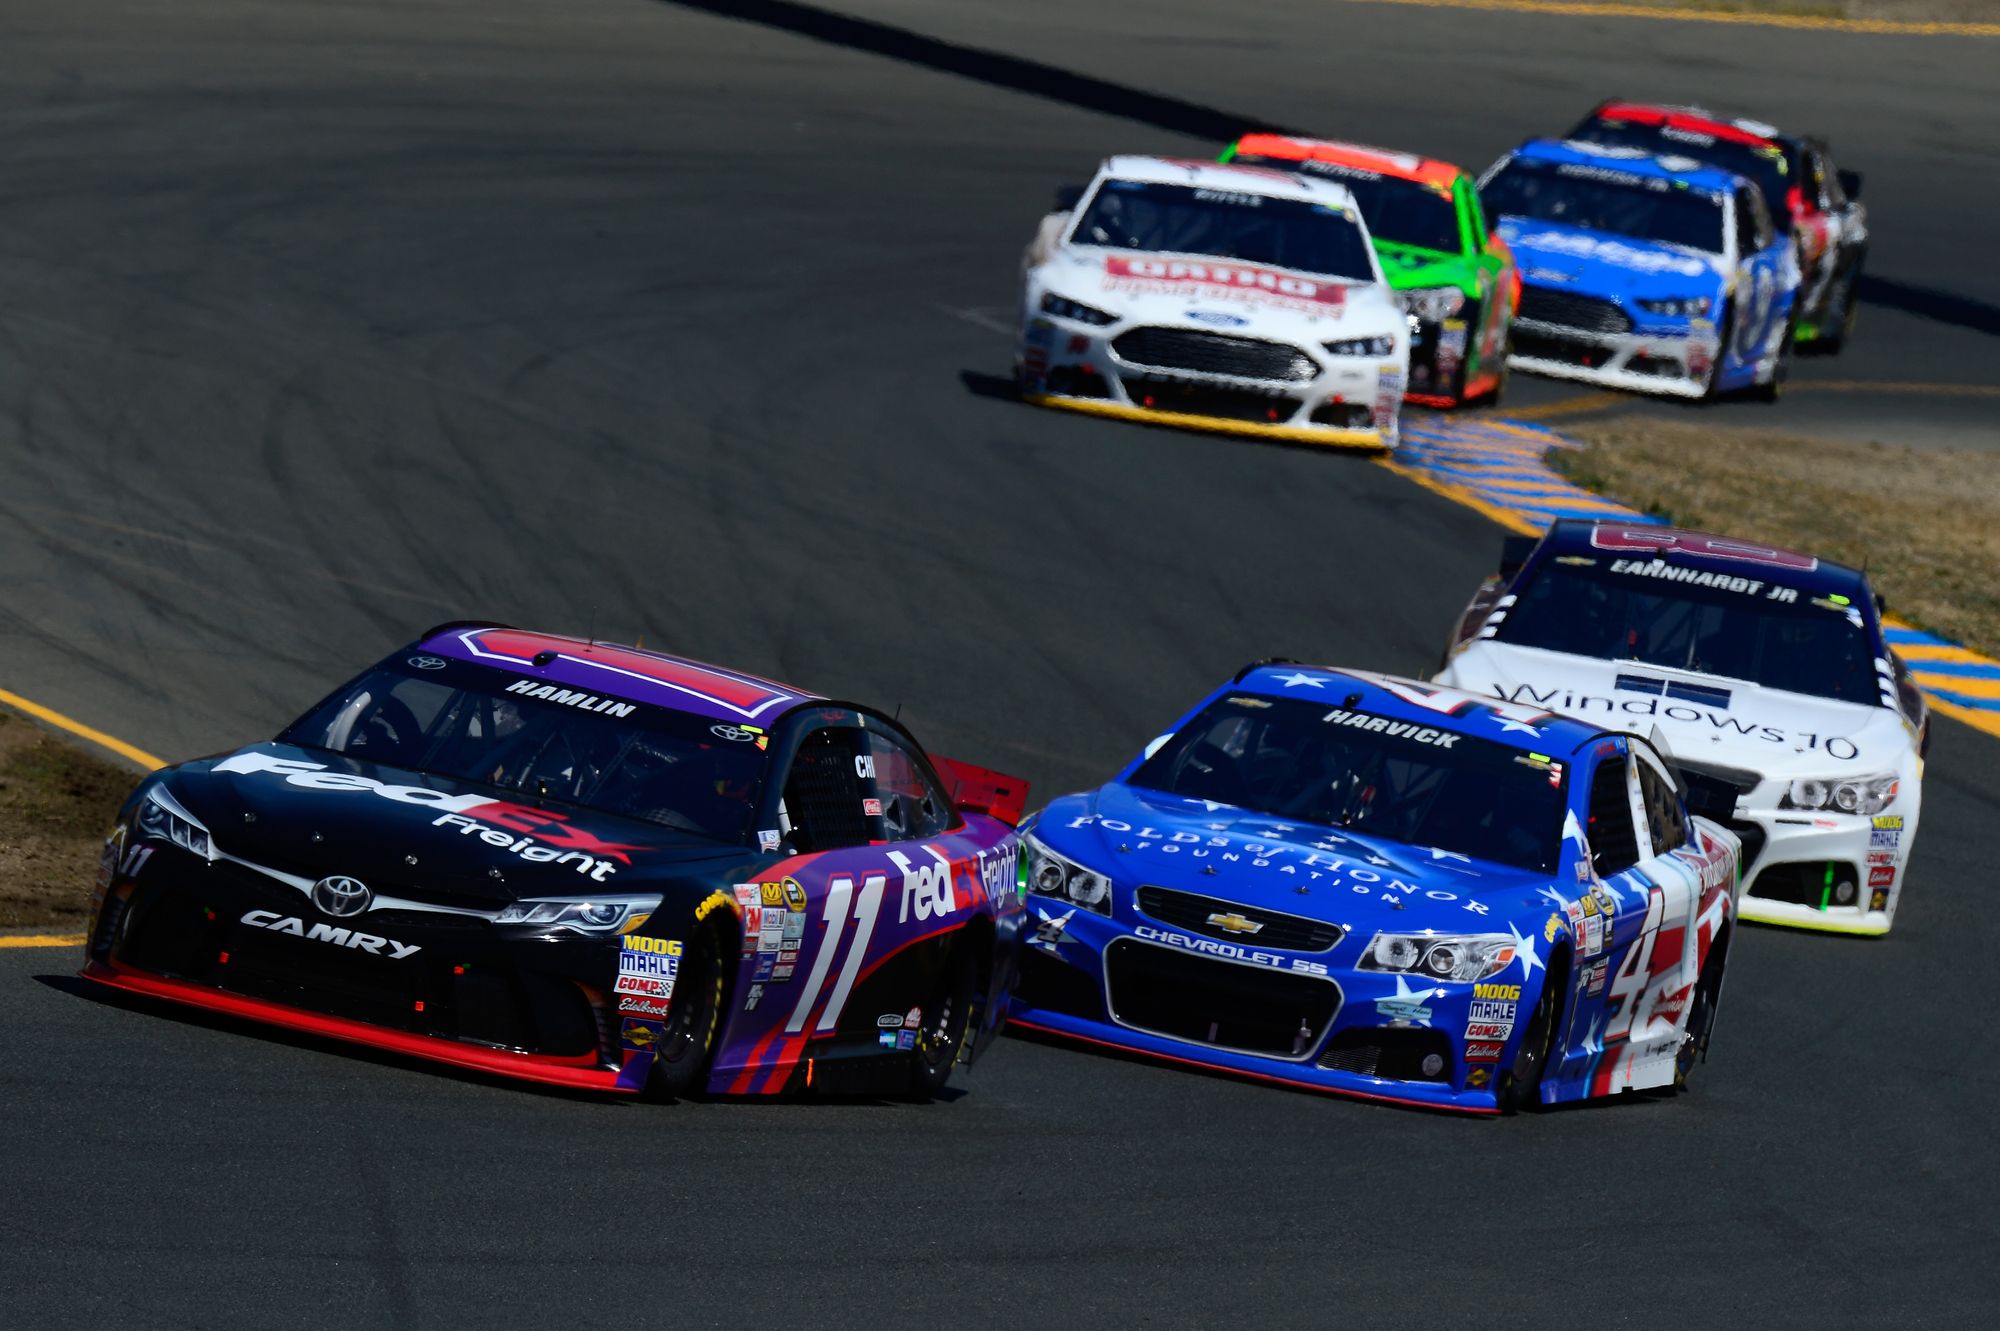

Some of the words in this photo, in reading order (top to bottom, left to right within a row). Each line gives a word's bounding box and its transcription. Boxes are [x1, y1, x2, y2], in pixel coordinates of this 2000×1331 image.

[1609, 557, 1765, 596] EARNHARDT
[1766, 585, 1799, 603] JR
[505, 679, 638, 718] HAMLIN
[1321, 708, 1462, 749] HARVICK
[1491, 683, 1785, 742] Windows
[1794, 732, 1855, 760] 10
[209, 751, 656, 866] FedEx
[430, 812, 617, 882] Freight
[1063, 812, 1230, 848] FOLDS
[1299, 853, 1490, 916] HONOR
[239, 909, 422, 959] CAMRY
[623, 934, 684, 957] MOOG
[783, 875, 887, 1034] 11
[1134, 925, 1286, 967] CHEVROLET
[1291, 958, 1329, 976] SS
[618, 977, 660, 993] COMP
[621, 953, 678, 976] MAHLE
[1470, 1002, 1515, 1019] MAHLE
[1472, 983, 1522, 1001] MOOG
[1468, 1024, 1499, 1037] COMP
